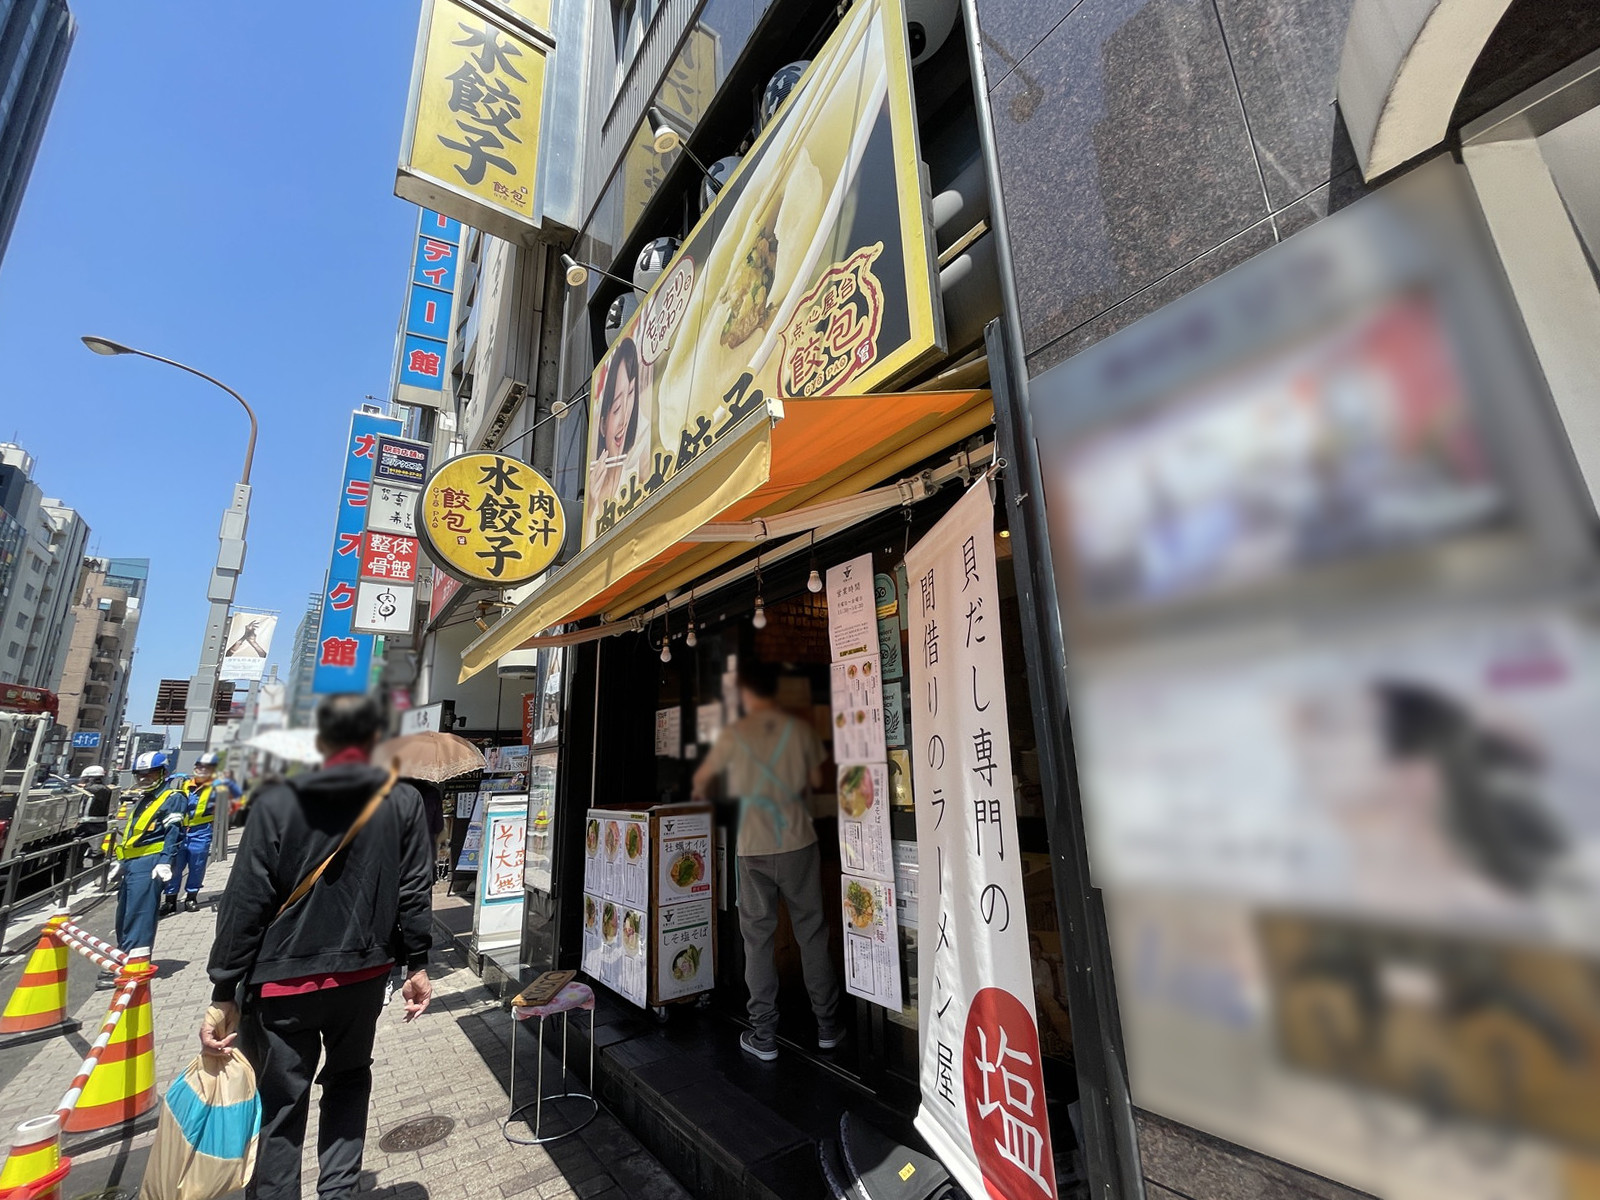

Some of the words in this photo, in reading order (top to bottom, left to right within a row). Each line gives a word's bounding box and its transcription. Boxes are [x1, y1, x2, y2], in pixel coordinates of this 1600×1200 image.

[437, 22, 528, 186] 水餃子
[789, 307, 865, 388] 餃包
[790, 277, 854, 346] 点心屋台
[370, 533, 414, 556] 整体
[440, 486, 473, 534] 餃包
[475, 457, 524, 577] 水餃子
[527, 489, 558, 548] 肉汁
[367, 556, 412, 579] 骨盤
[961, 535, 1010, 933] 貝だし専門の
[919, 567, 956, 1108] 間借りのラーメン屋
[663, 926, 709, 947] しそ塩そば
[974, 1024, 1053, 1199] 塩
